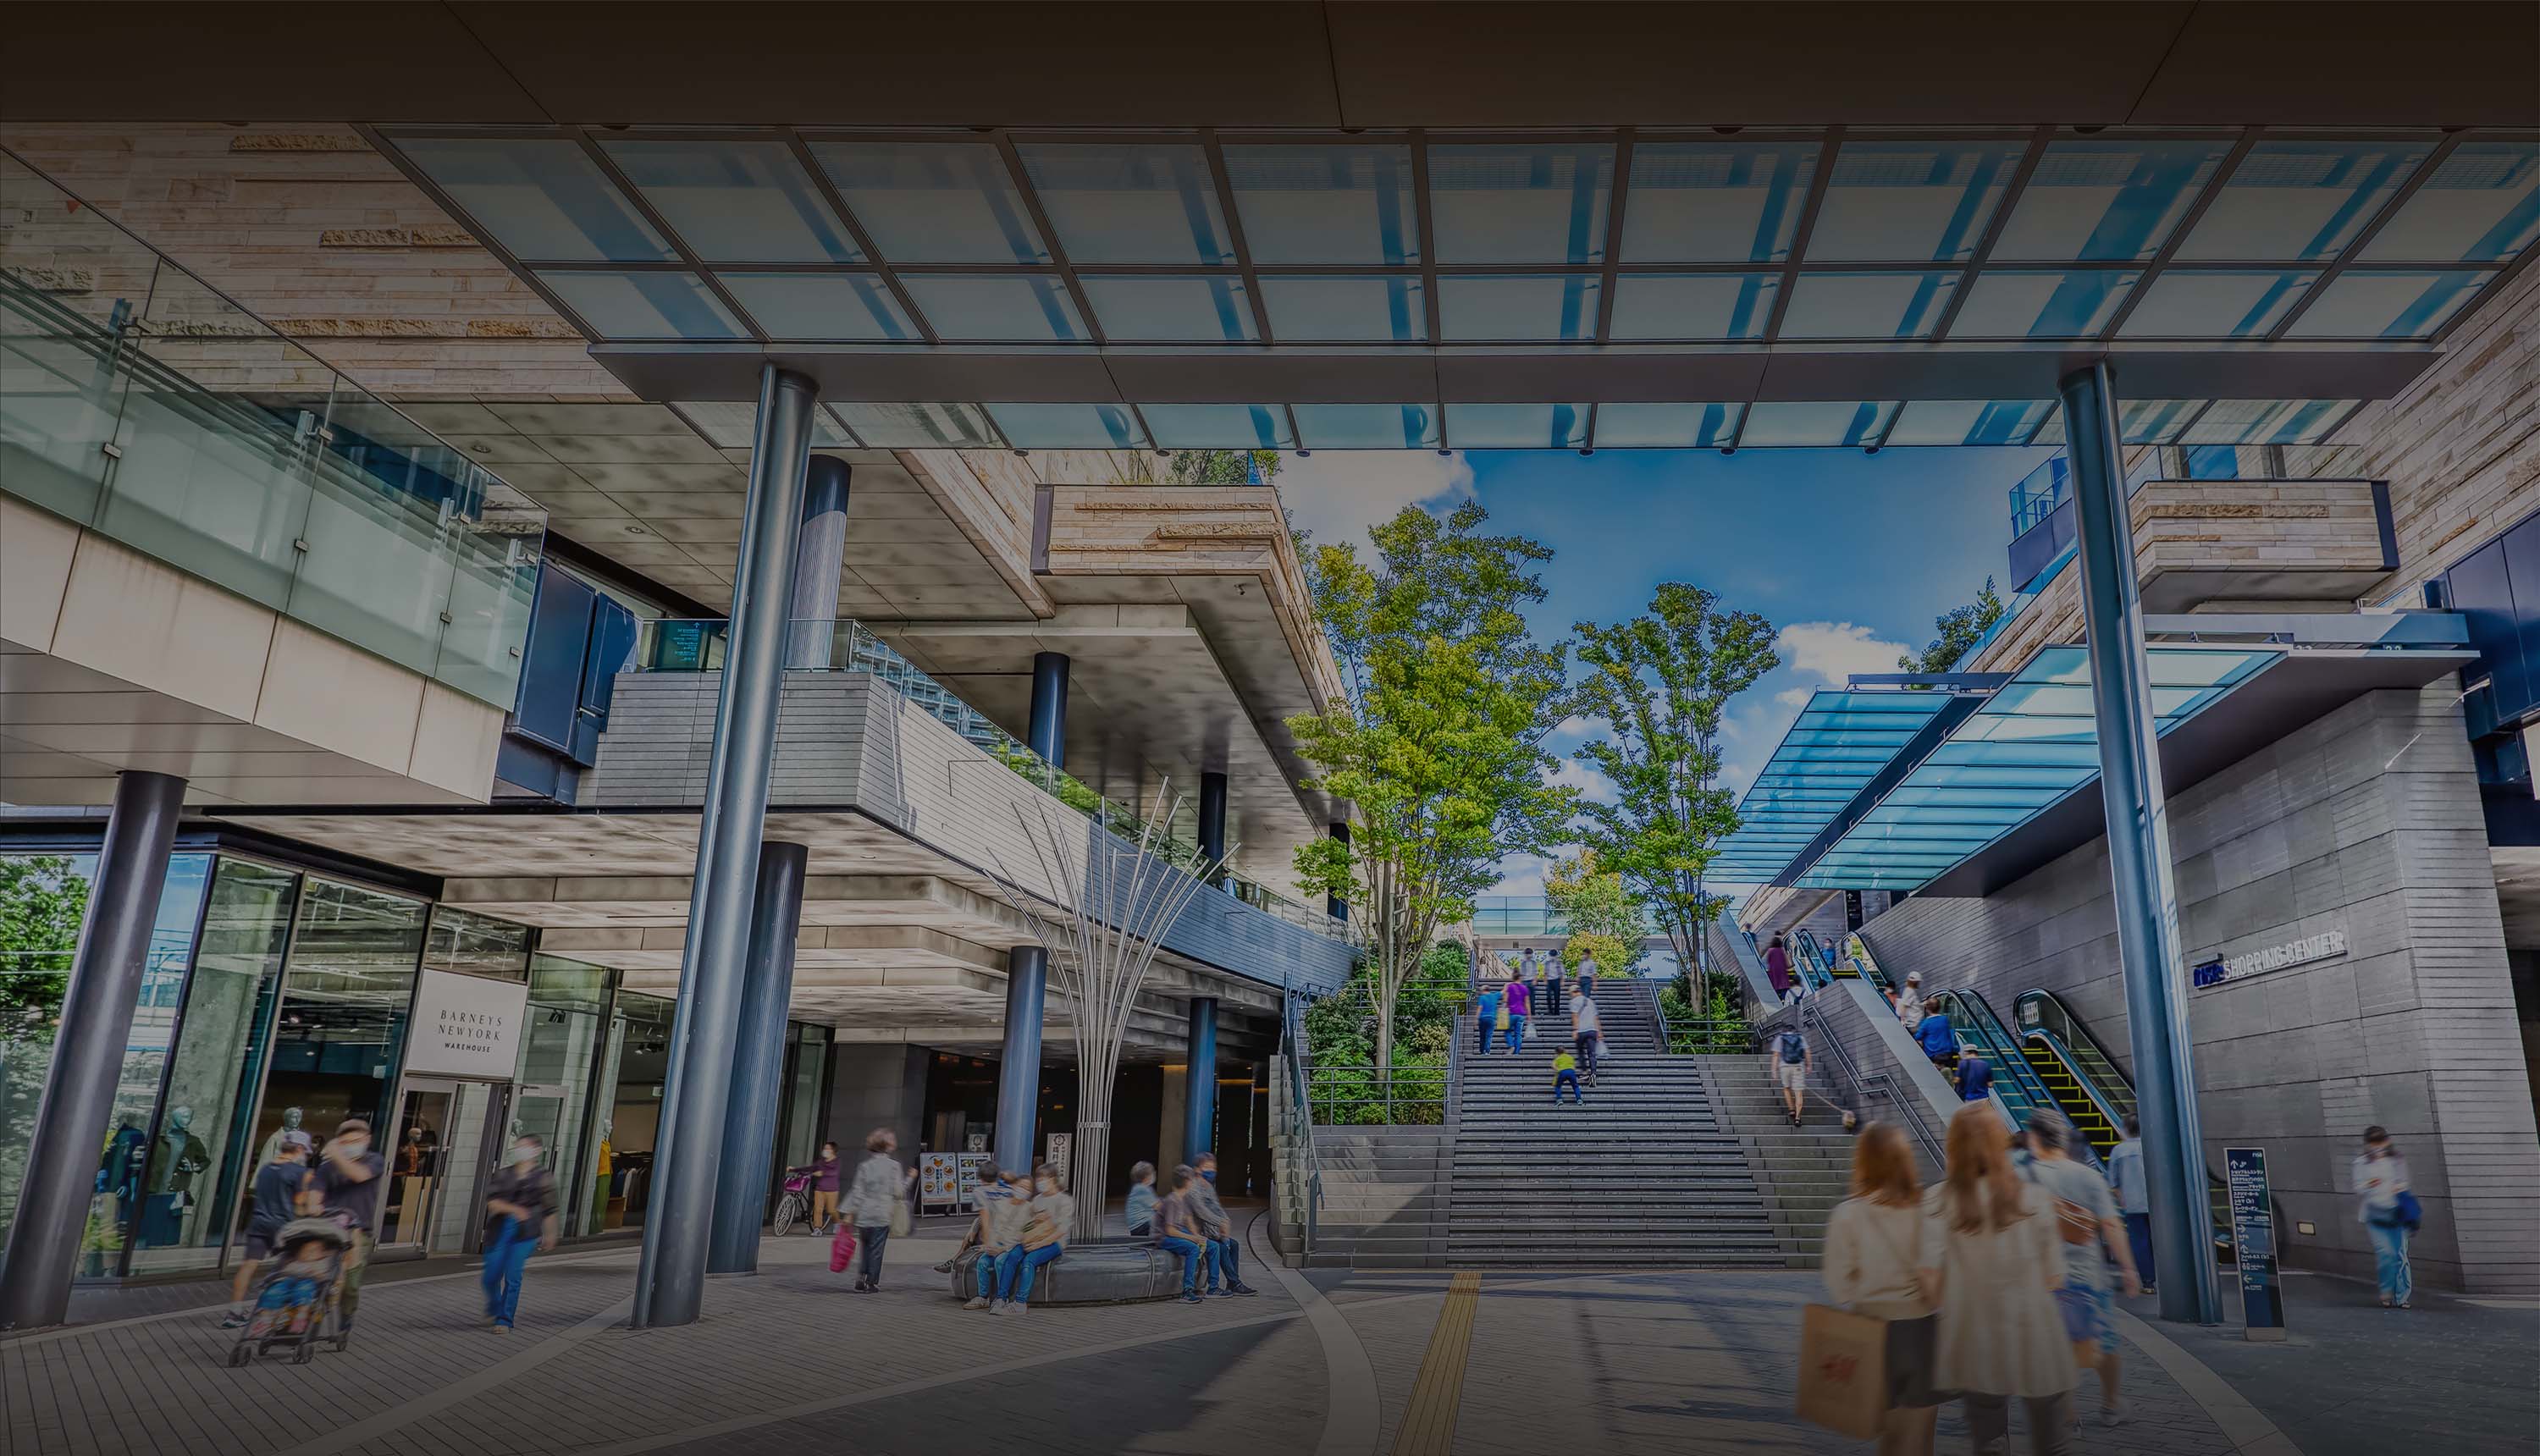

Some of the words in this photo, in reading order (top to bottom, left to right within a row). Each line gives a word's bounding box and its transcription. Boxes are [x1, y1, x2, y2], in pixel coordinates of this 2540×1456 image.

[2223, 946, 2286, 979] SHOPPING
[2286, 930, 2344, 963] CENTER
[440, 1010, 502, 1027] BARNEYS
[444, 1043, 491, 1052] WAREHOUSE
